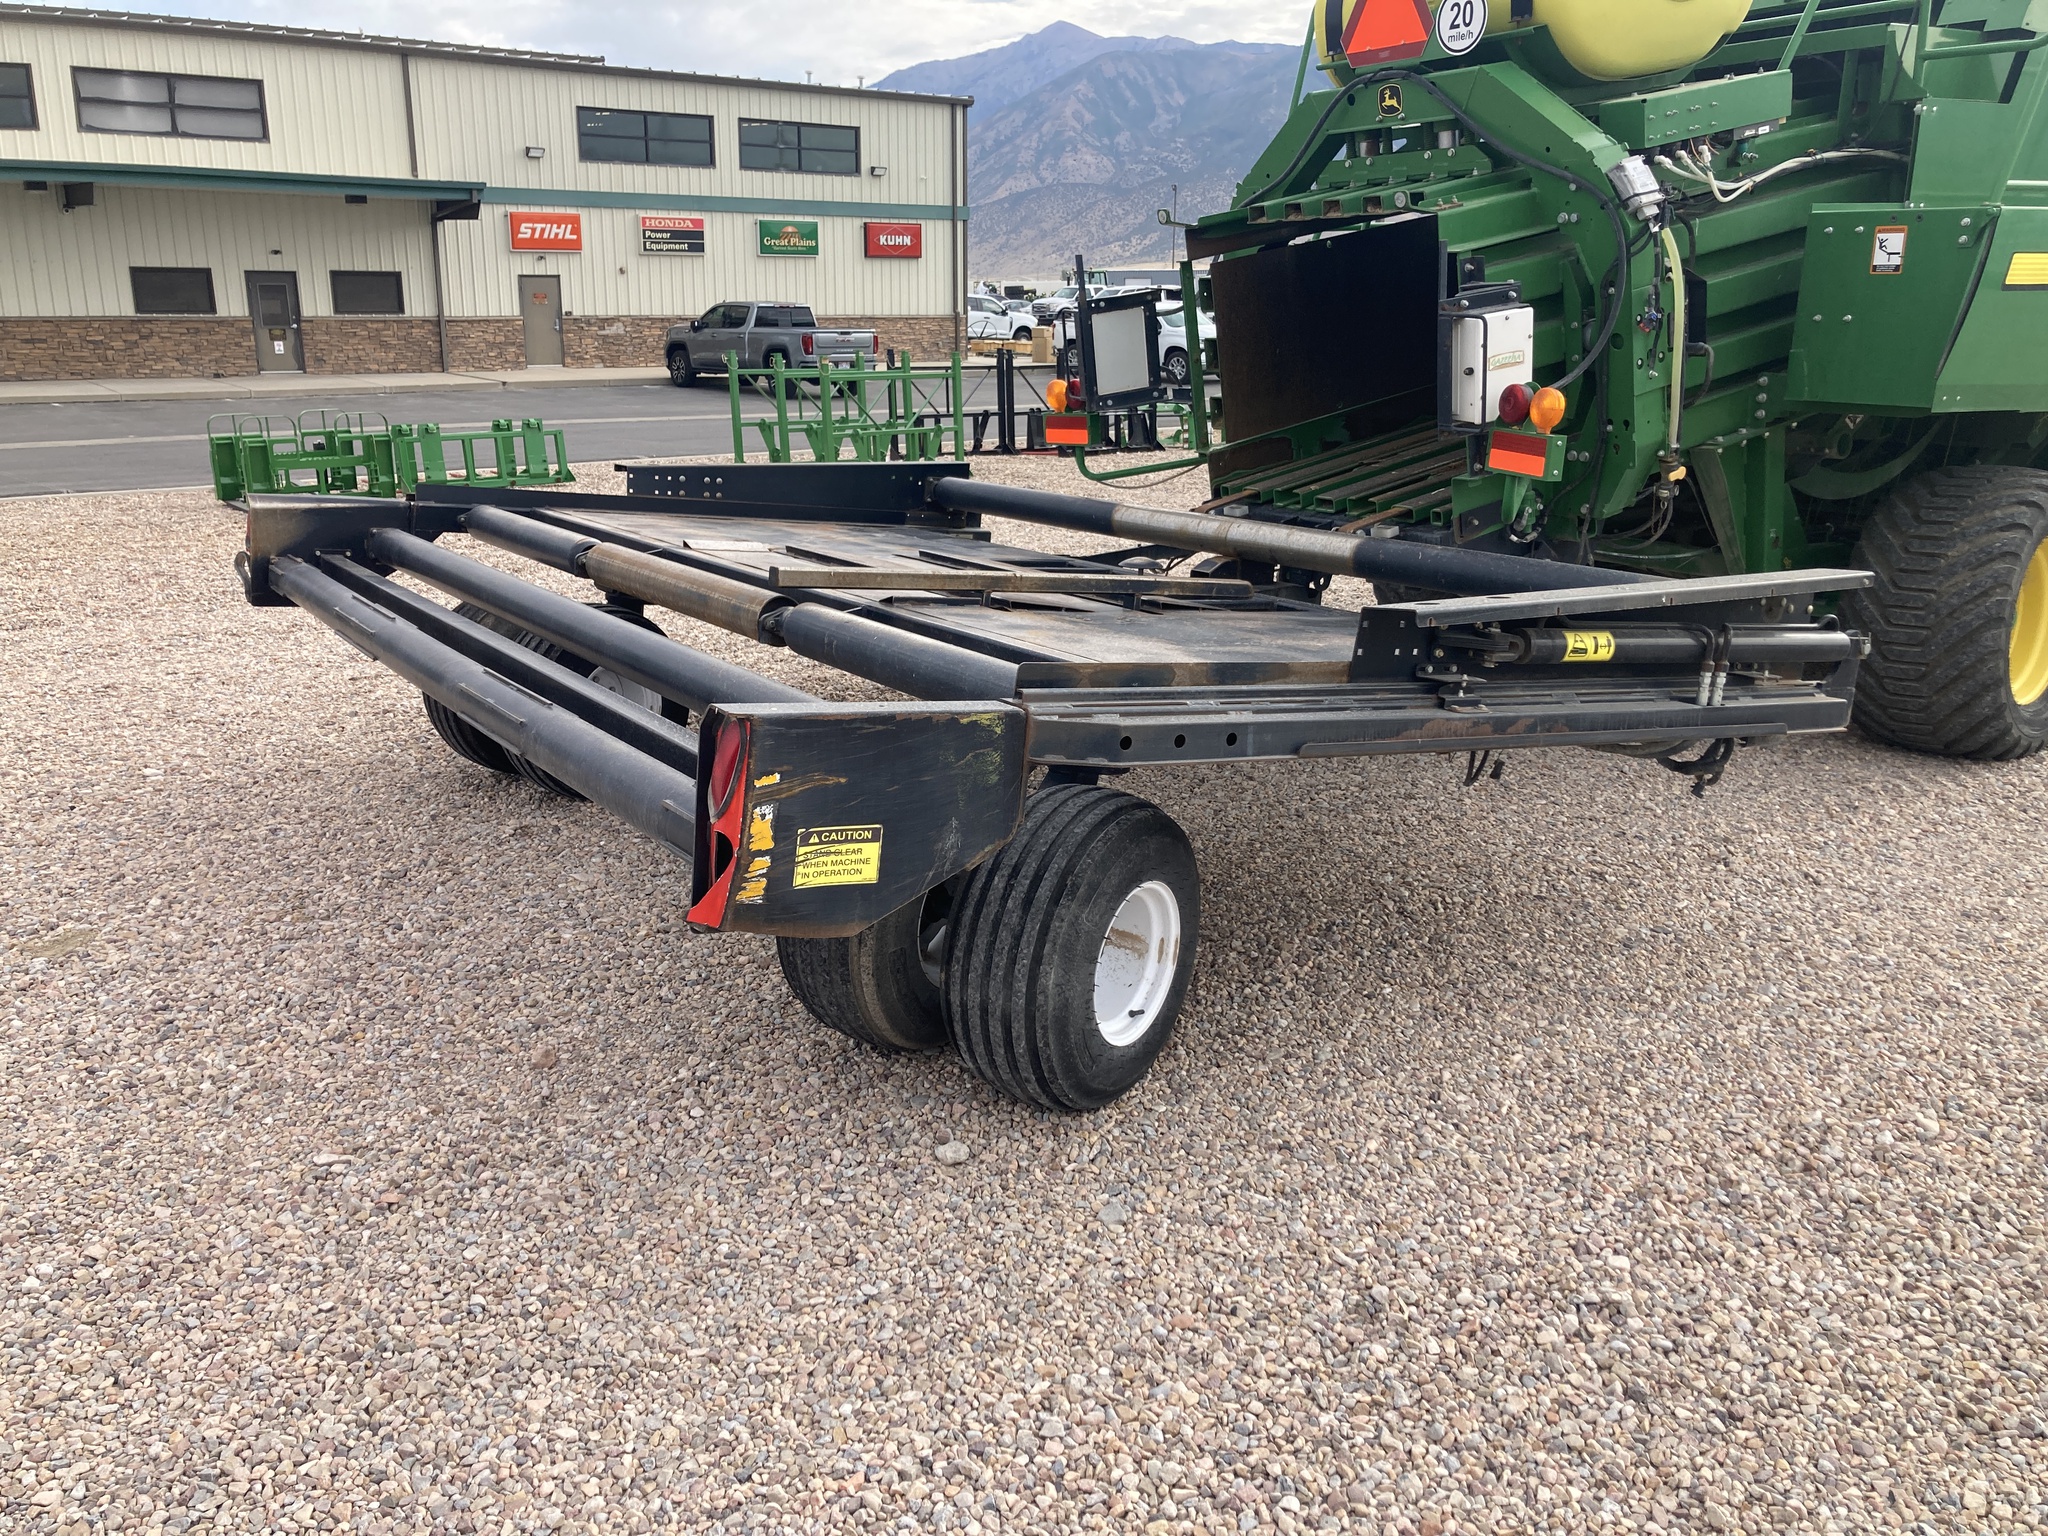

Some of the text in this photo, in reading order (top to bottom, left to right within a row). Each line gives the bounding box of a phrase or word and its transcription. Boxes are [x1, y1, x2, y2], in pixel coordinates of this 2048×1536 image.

[1449, 0, 1474, 30] 20
[1447, 30, 1474, 43] mile/h
[645, 218, 694, 228] HONDA
[517, 222, 577, 240] STIHL
[645, 230, 671, 239] Power
[645, 241, 688, 251] Equipment
[763, 236, 816, 247] Great Plains
[879, 235, 911, 246] KUHN
[821, 830, 872, 842] CAUTION
[834, 847, 863, 857] CLEAR
[802, 857, 871, 869] WHEN MACHINE
[812, 867, 862, 878] OPERATION
